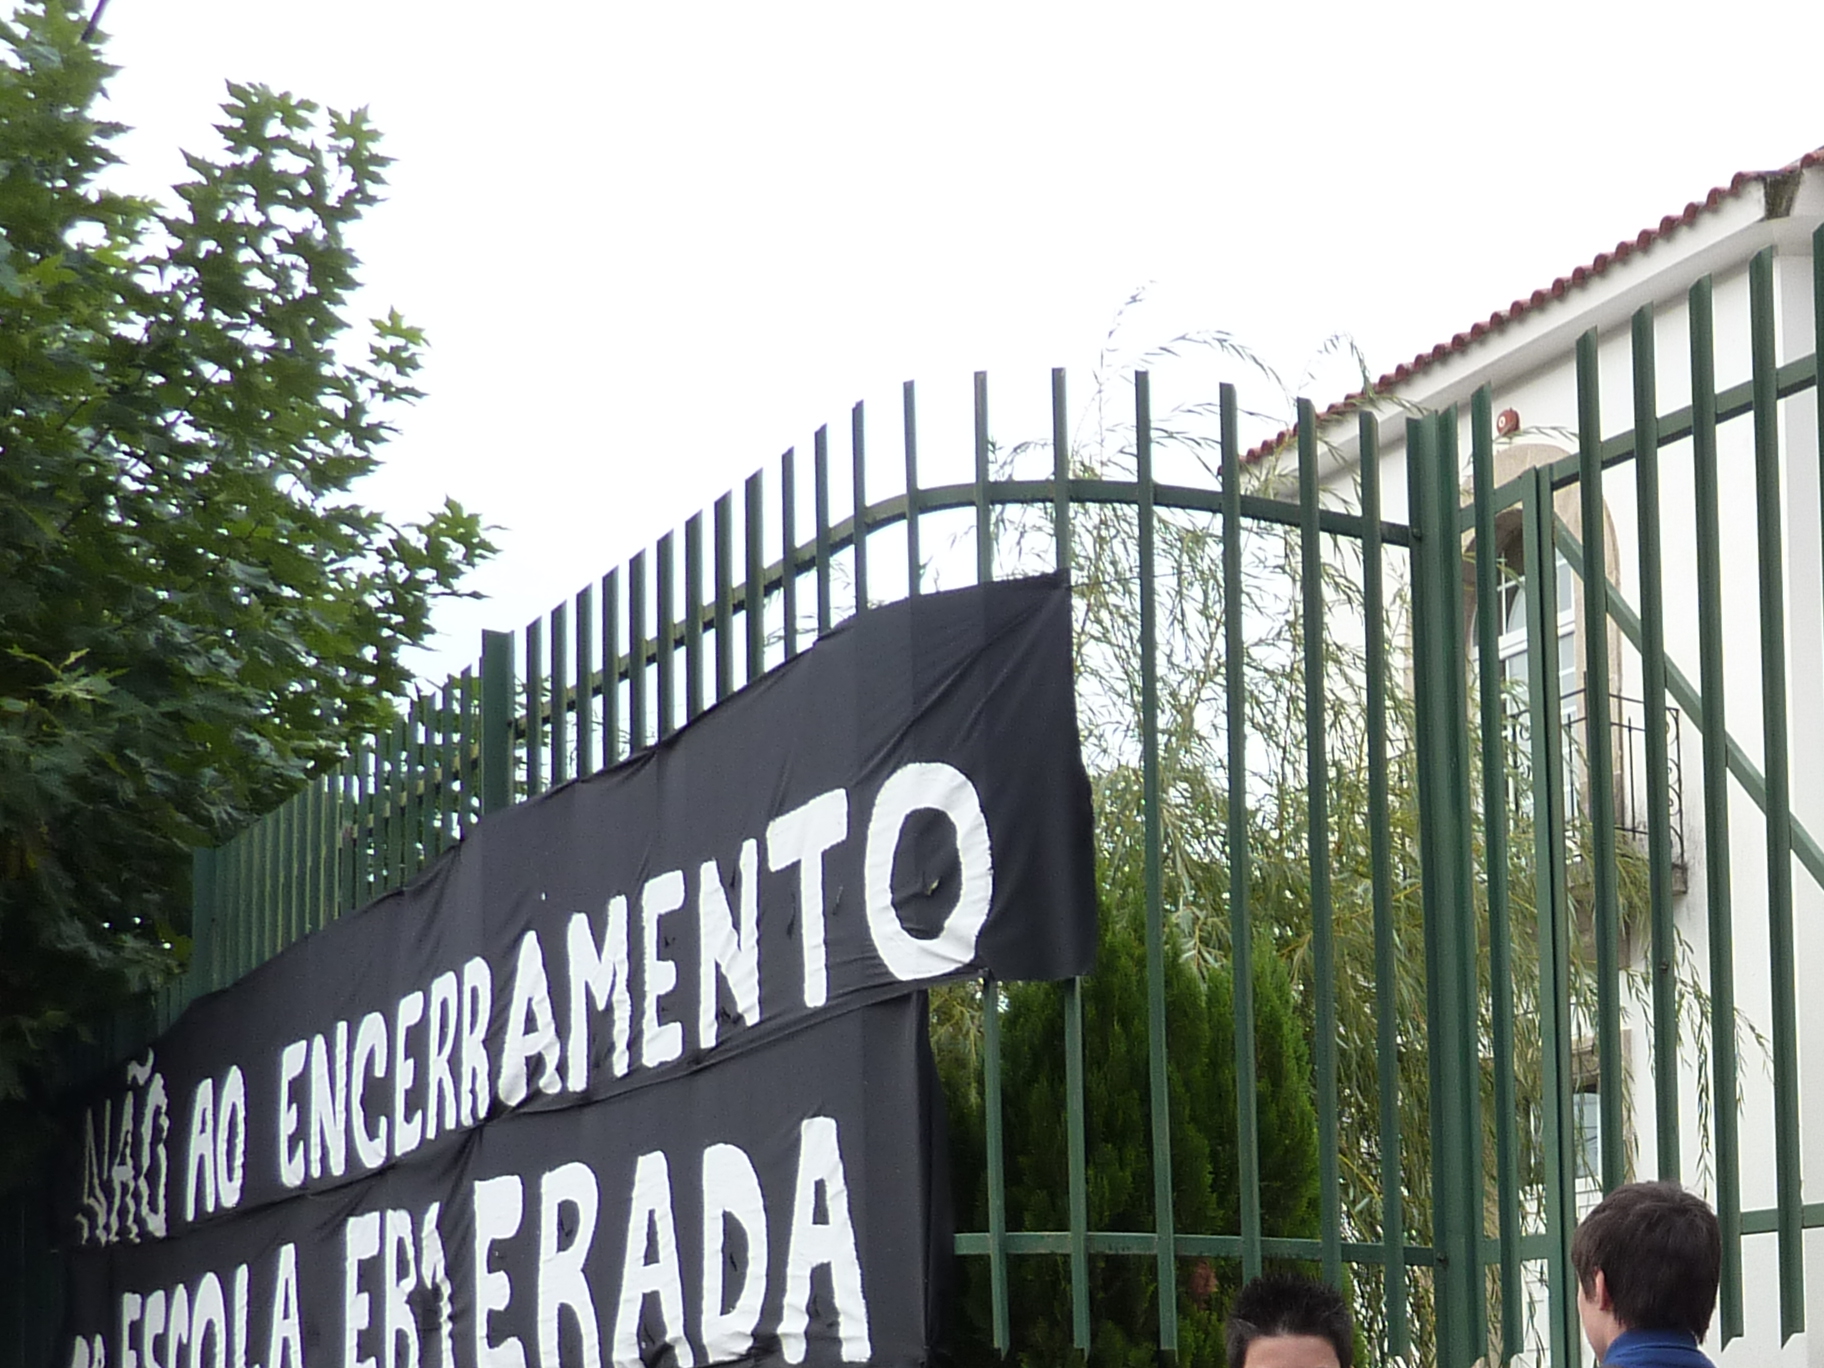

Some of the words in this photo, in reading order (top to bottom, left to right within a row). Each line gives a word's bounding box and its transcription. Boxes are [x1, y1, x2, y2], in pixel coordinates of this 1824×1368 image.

[76, 1047, 169, 1246] NÃO
[186, 1064, 245, 1222] AO
[279, 761, 993, 1188] ENCERRAMENTO
